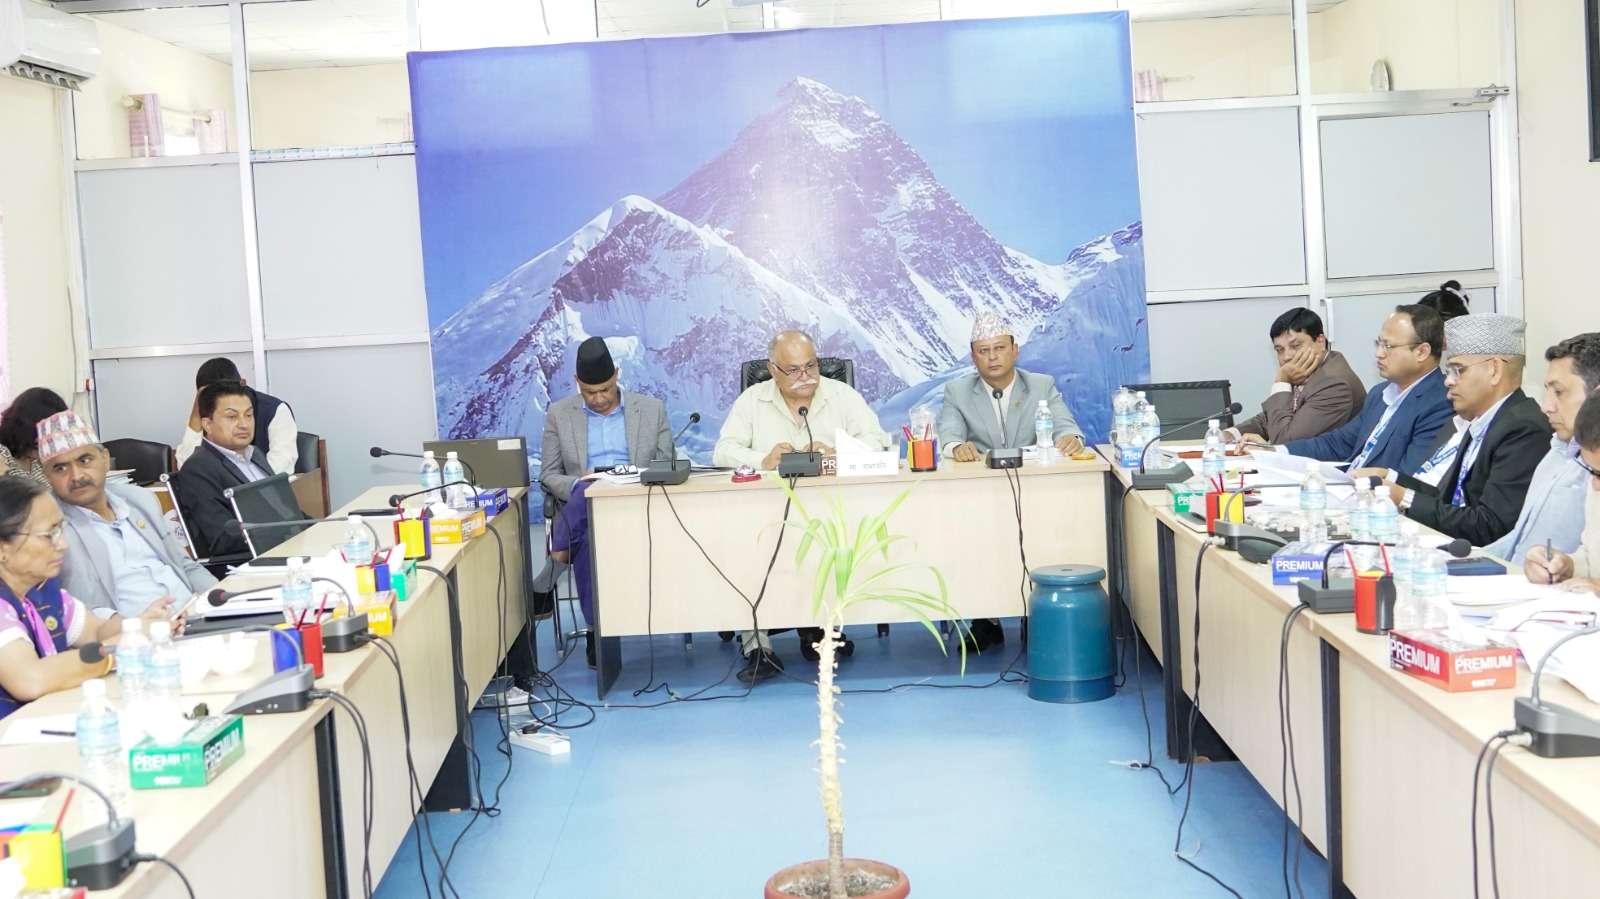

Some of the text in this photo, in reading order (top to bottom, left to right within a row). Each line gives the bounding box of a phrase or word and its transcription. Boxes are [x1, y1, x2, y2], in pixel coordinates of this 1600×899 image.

[1276, 560, 1324, 570] PREMIUM
[1390, 639, 1440, 675] PREMIUM
[1455, 655, 1513, 671] PREMIUM
